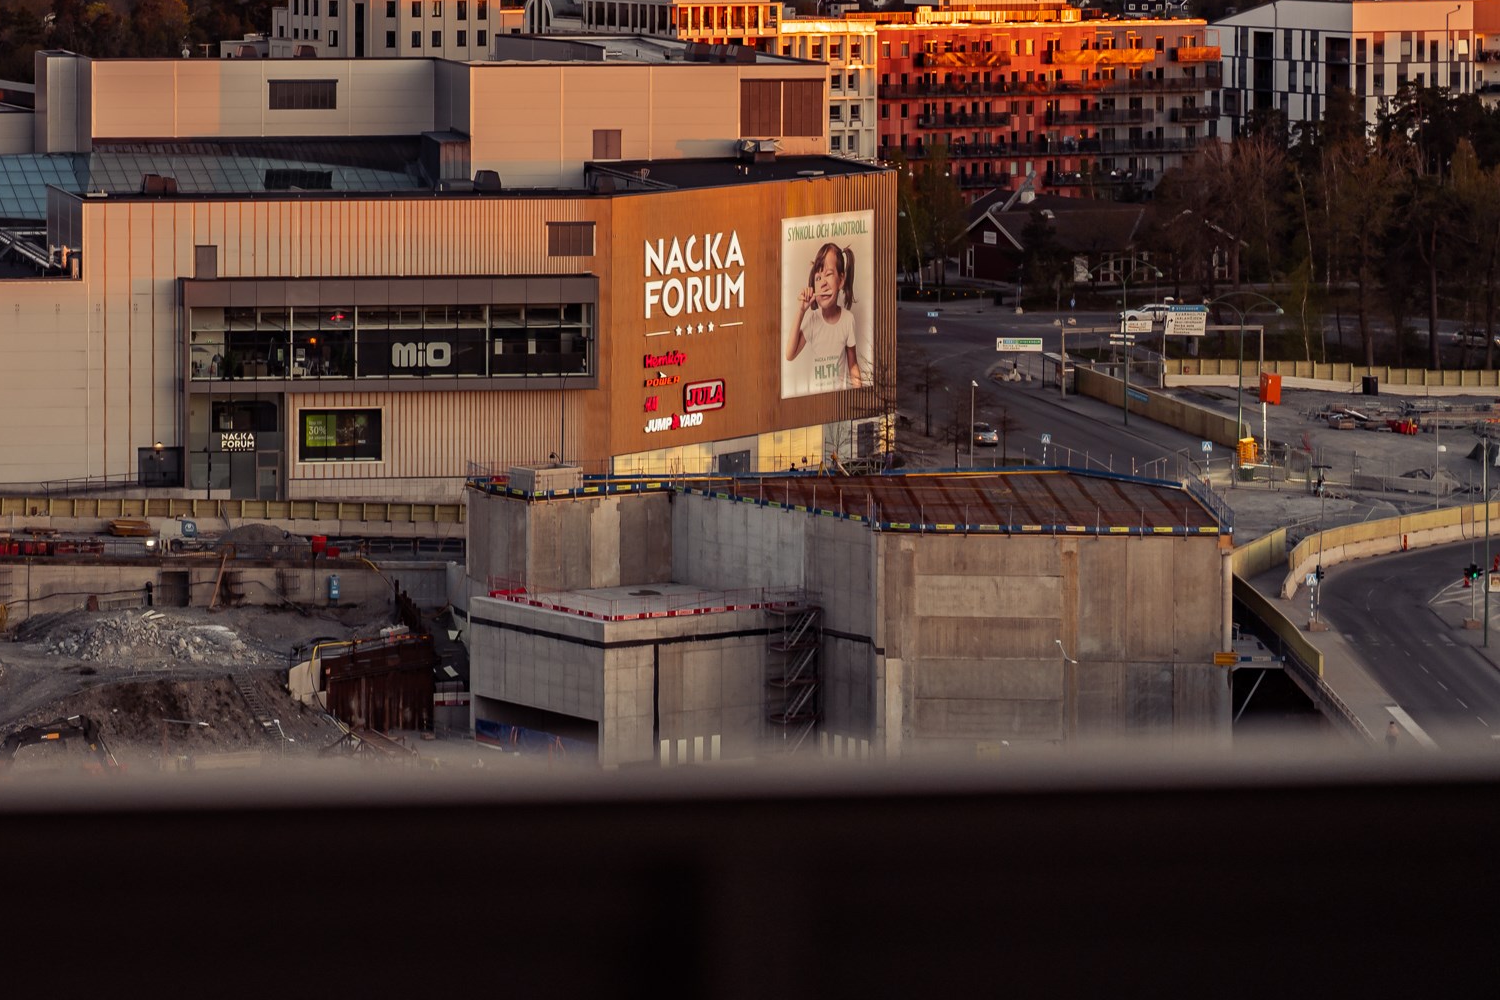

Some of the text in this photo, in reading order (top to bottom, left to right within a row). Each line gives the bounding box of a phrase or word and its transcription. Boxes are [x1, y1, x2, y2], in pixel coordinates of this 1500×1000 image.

[816, 223, 830, 239] OCH
[645, 229, 745, 277] NACKA
[645, 270, 745, 319] FORUM
[645, 350, 687, 369] Hemköp
[814, 363, 840, 379] HLTH
[646, 375, 680, 387] POWER
[687, 385, 724, 407] JULA
[221, 432, 254, 440] NACKA
[221, 440, 254, 448] FORUM
